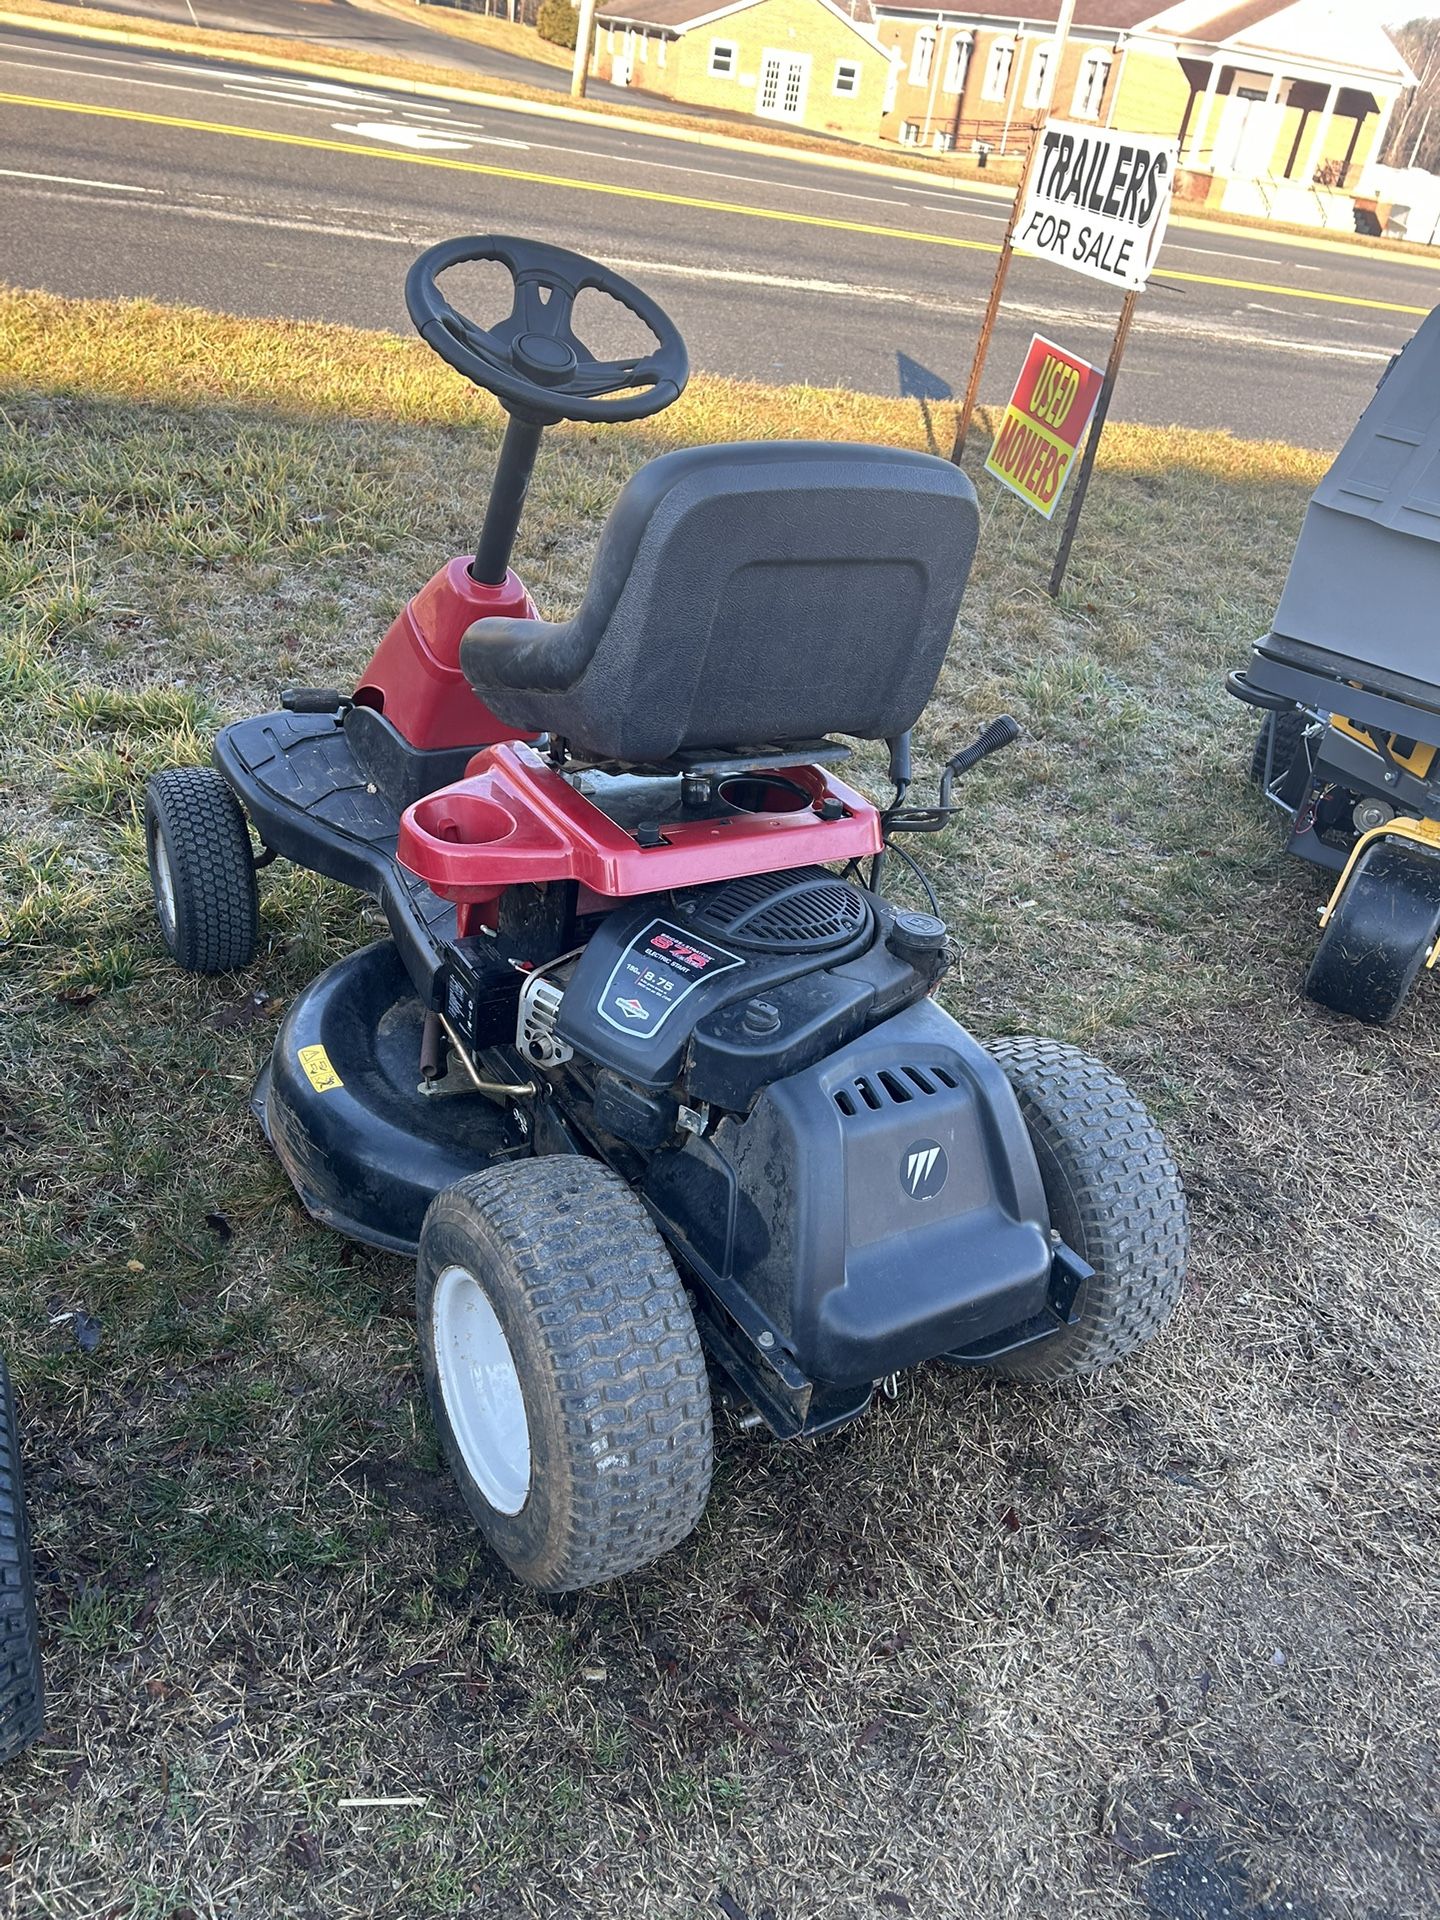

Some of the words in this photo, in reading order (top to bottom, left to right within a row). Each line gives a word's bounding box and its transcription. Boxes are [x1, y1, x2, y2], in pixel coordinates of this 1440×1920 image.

[1036, 131, 1168, 228] TRAILERS
[1022, 210, 1071, 255] FOR
[1072, 226, 1134, 277] SALE
[1029, 352, 1080, 430] USED
[991, 414, 1069, 504] MOWERS
[644, 948, 672, 964] ELECTRIC
[670, 961, 691, 973] START
[644, 971, 675, 991] 8.75
